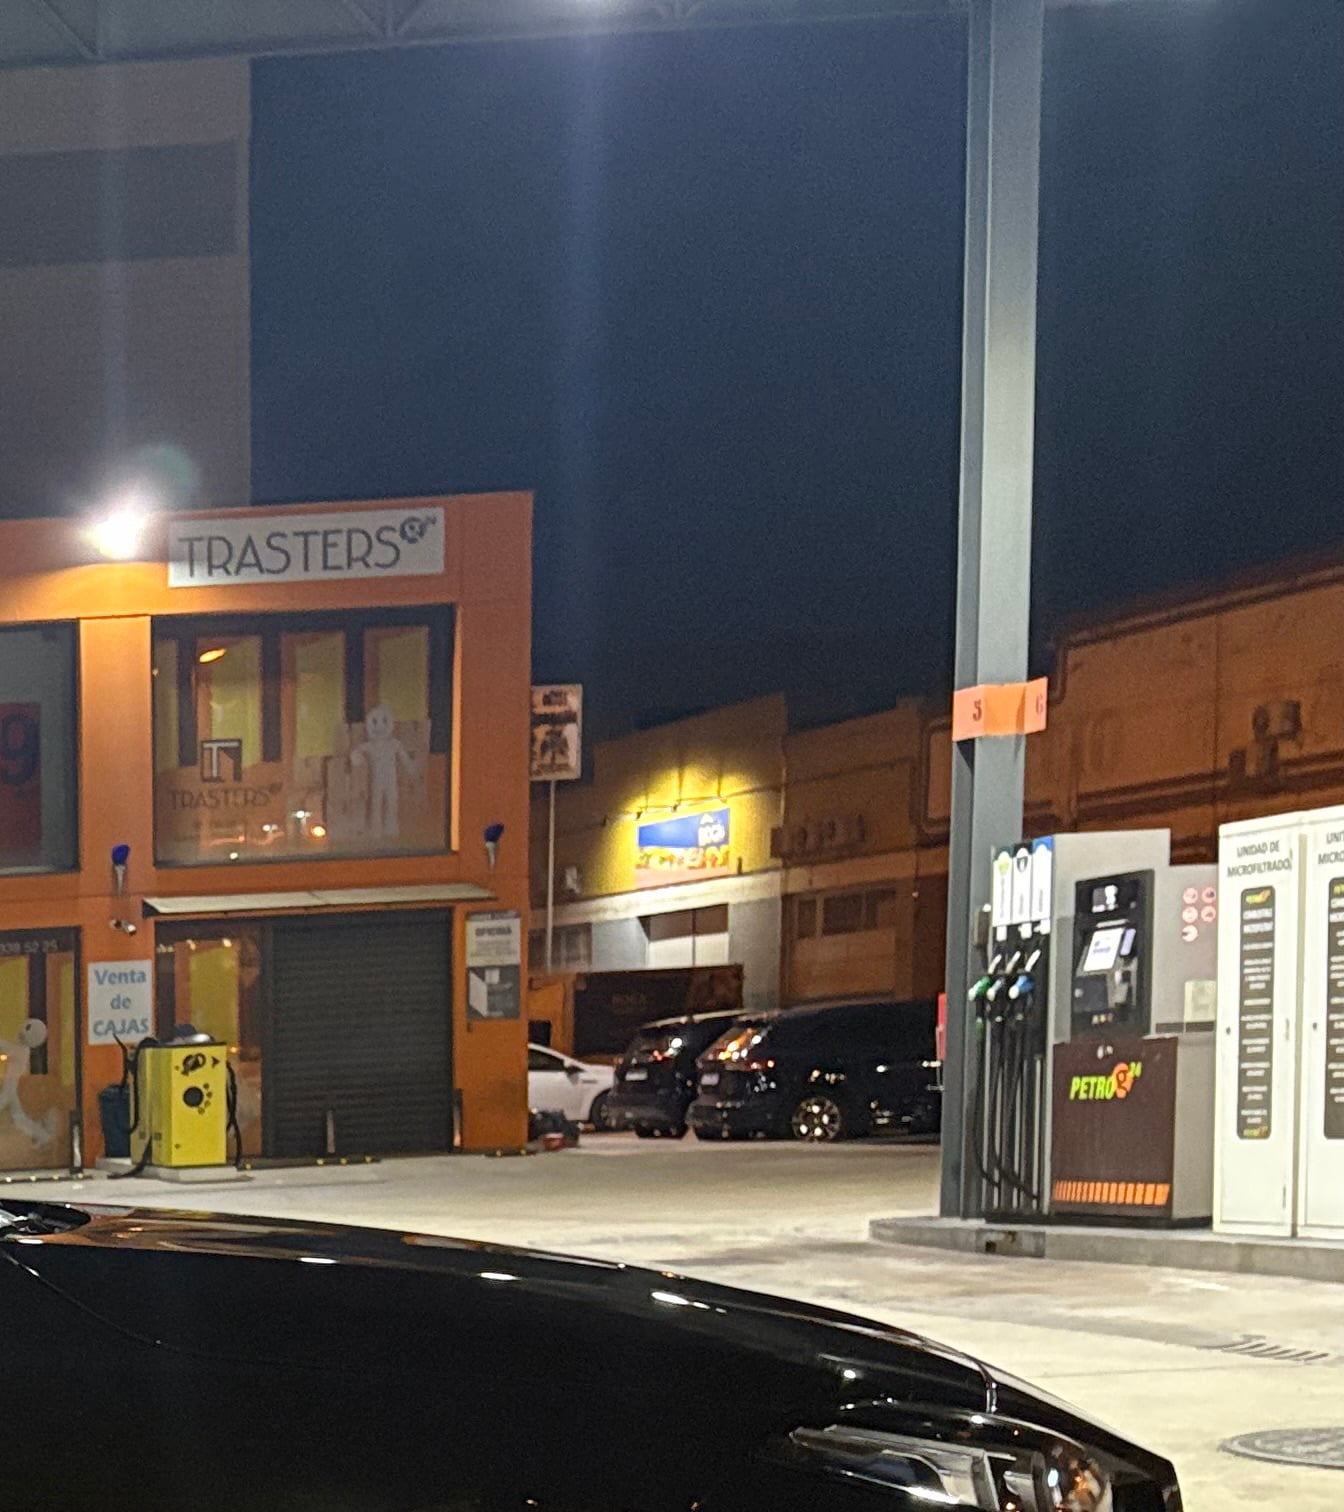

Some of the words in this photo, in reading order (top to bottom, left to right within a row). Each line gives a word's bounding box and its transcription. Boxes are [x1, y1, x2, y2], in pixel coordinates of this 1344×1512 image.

[178, 526, 402, 578] TRASTERS
[94, 968, 147, 985] Venta
[110, 993, 132, 1010] de
[93, 1018, 150, 1037] CAJAS
